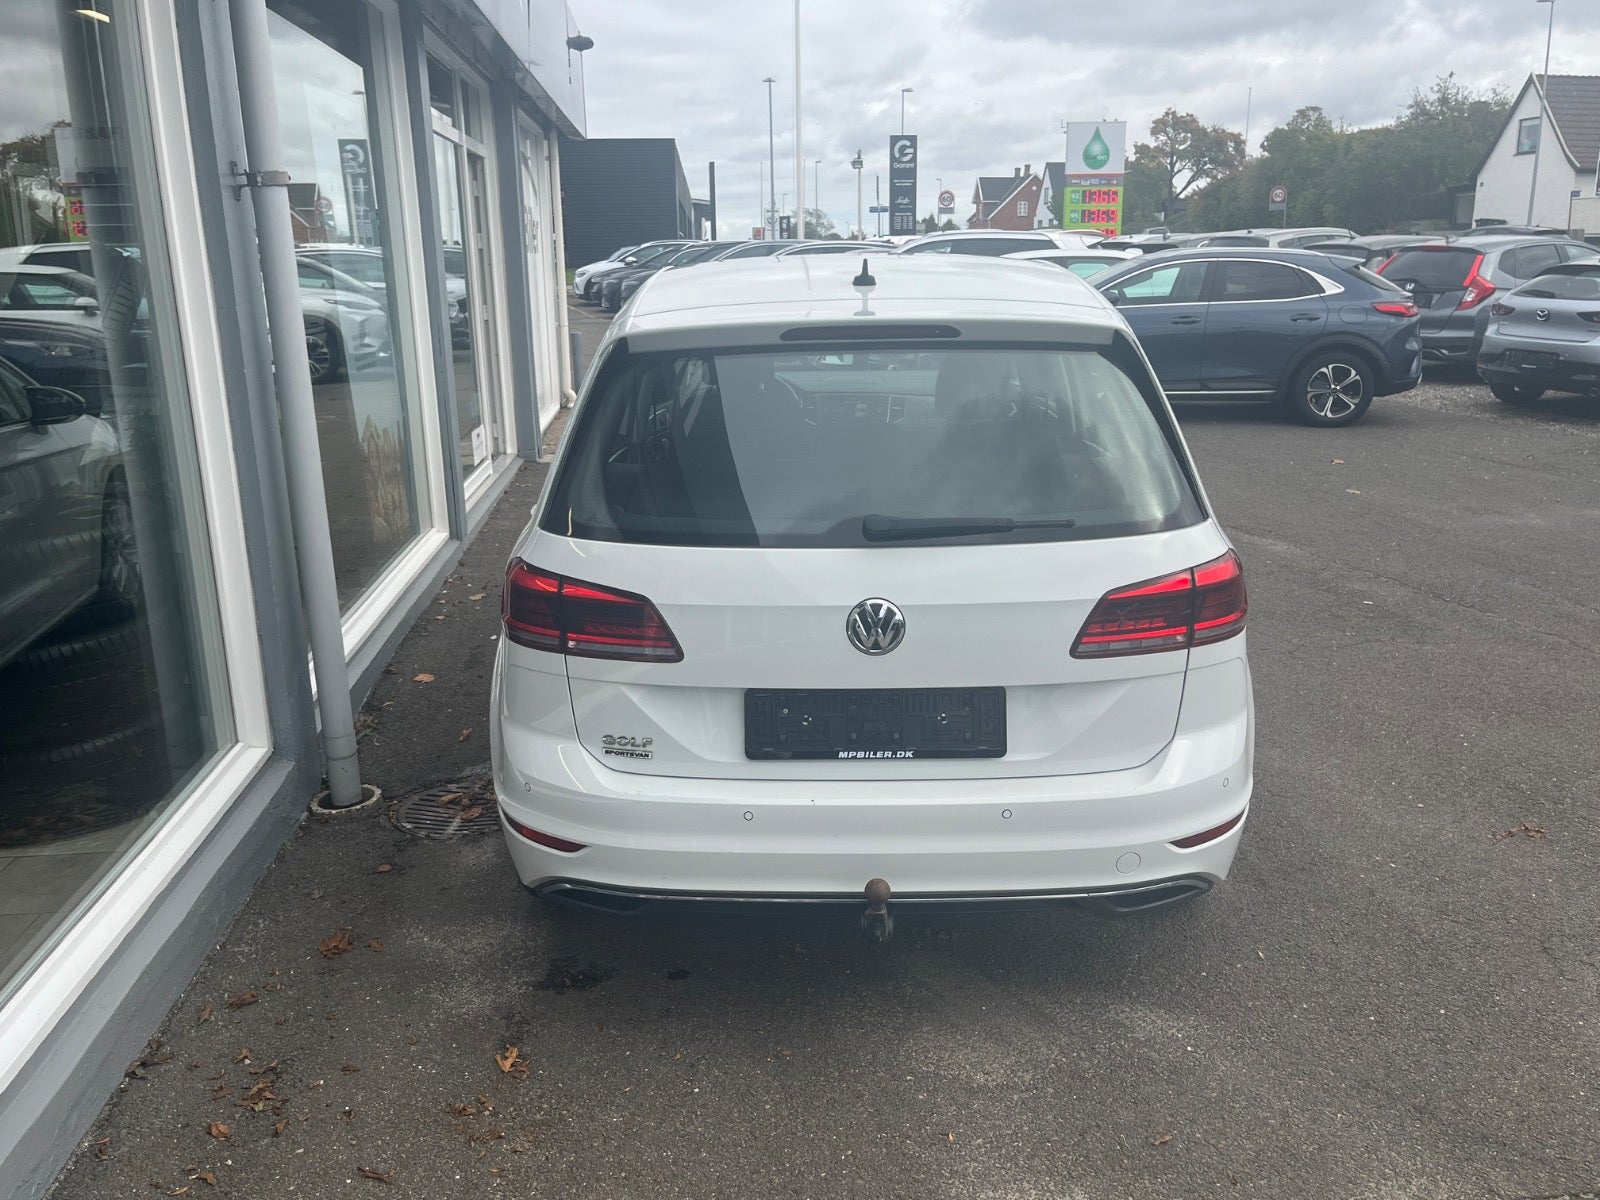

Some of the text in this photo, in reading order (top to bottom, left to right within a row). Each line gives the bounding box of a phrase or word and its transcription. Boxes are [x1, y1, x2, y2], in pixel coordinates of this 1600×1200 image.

[942, 195, 951, 203] 60
[1274, 191, 1283, 199] 60
[602, 735, 653, 748] GOLF
[605, 749, 650, 758] SPORTSVAN
[838, 750, 914, 759] MPBILER.DK
